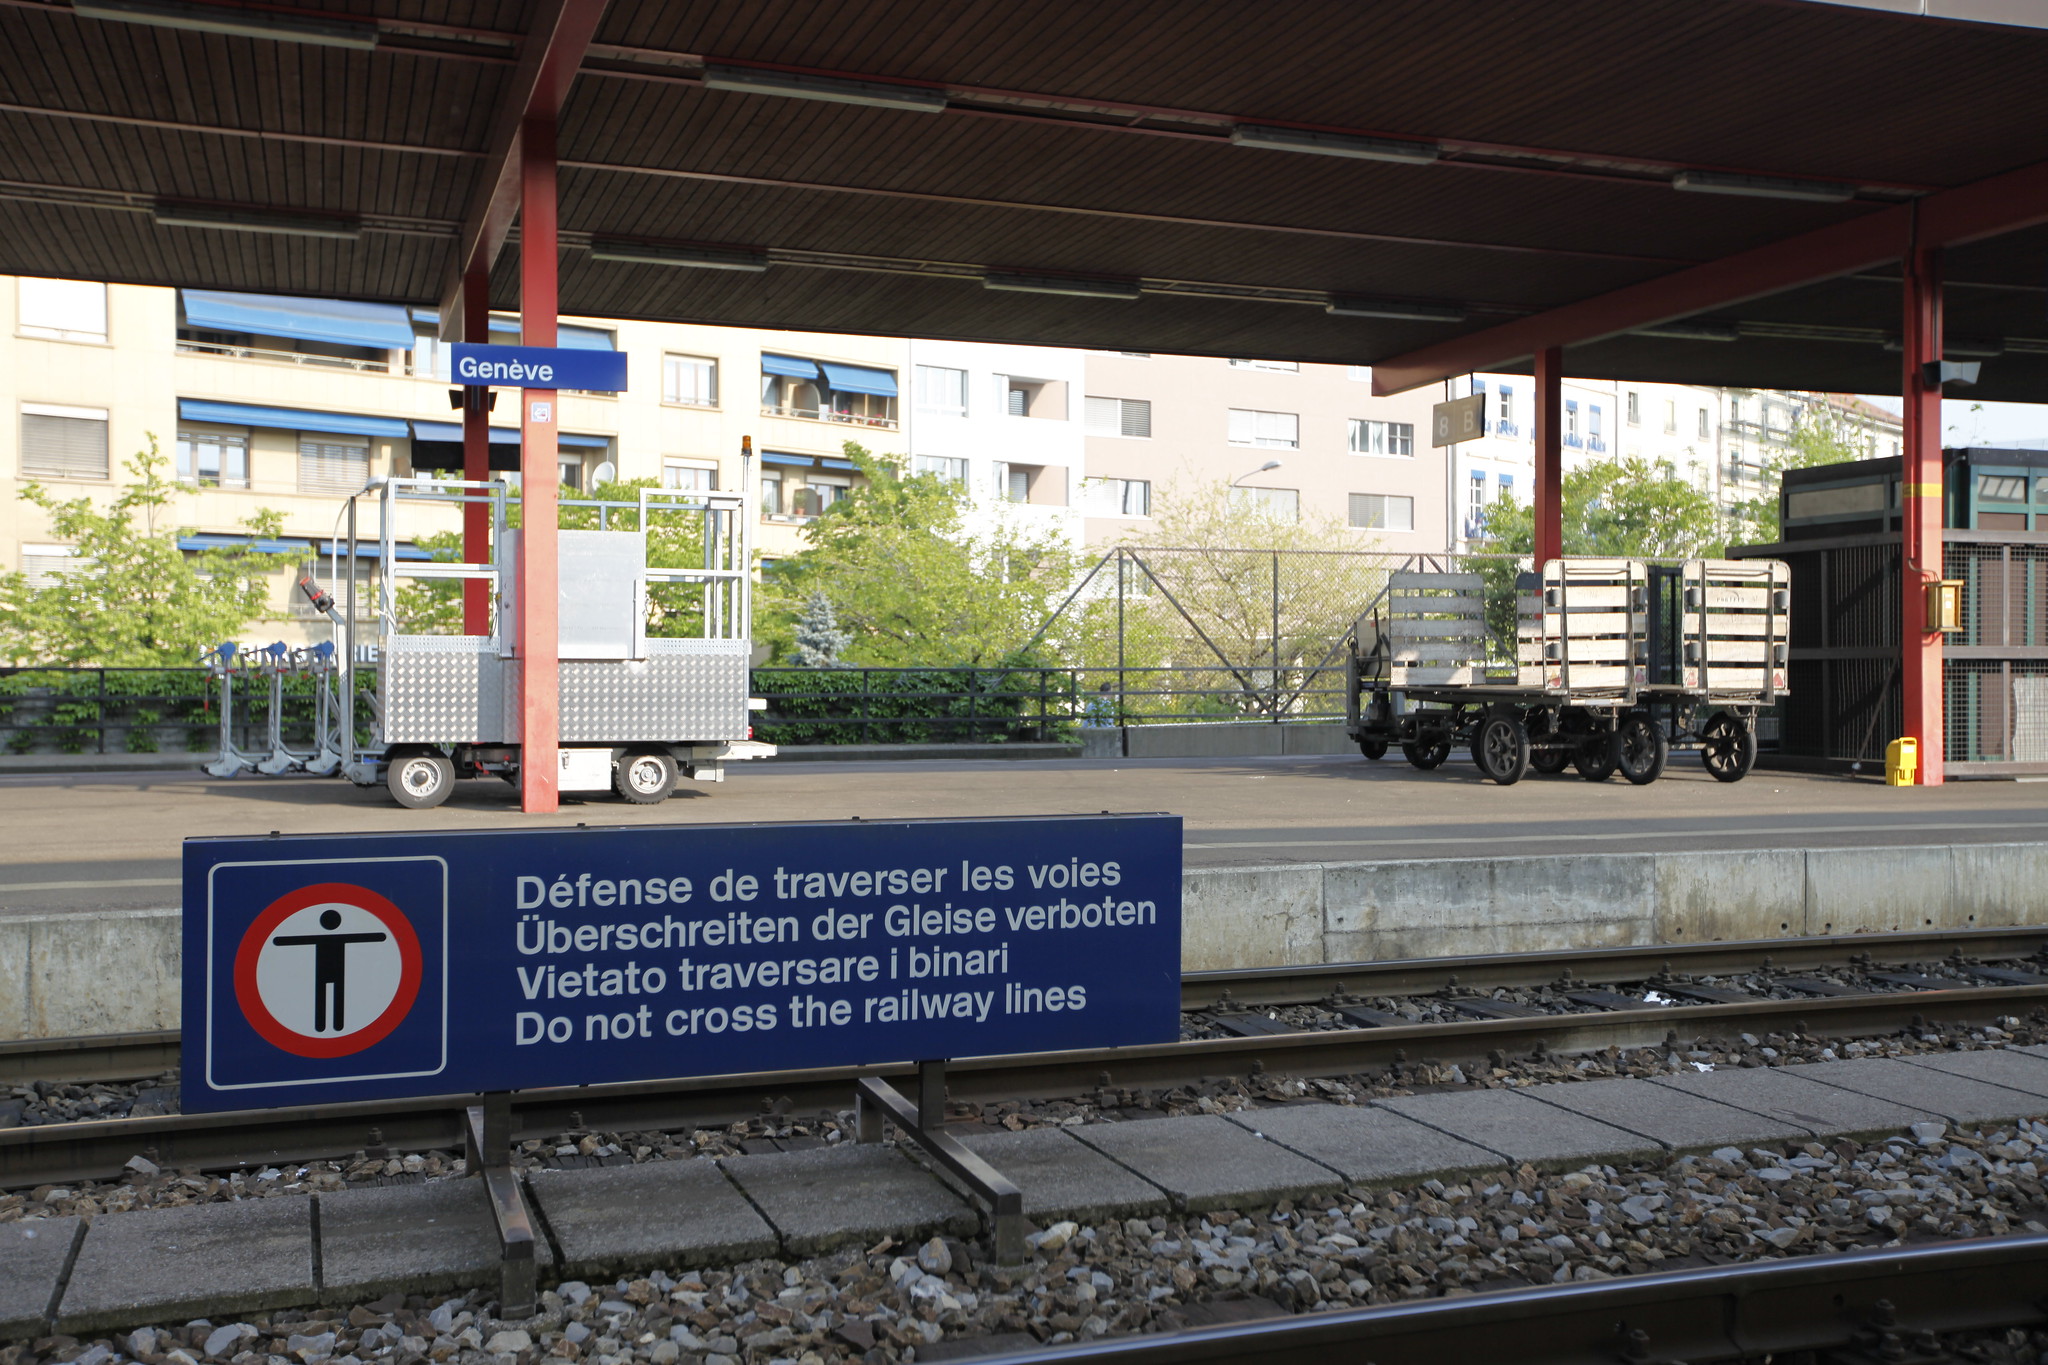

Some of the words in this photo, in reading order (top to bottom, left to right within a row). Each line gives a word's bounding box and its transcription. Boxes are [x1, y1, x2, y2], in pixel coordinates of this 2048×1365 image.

[459, 357, 553, 382] Genève
[1440, 416, 1449, 437] 8
[1464, 410, 1474, 432] B
[516, 873, 693, 909] Défense
[709, 869, 759, 902] de
[773, 866, 948, 900] traverser
[962, 860, 1015, 891] les
[1027, 857, 1121, 889] voies
[516, 911, 799, 955] Überschreiten
[811, 908, 874, 941] der
[884, 903, 996, 937] Gleise
[1004, 896, 1156, 932] verboten
[516, 961, 667, 1000] Vietato
[678, 954, 879, 992] traversare
[890, 947, 898, 979] i
[909, 942, 1008, 978] binari
[516, 1011, 573, 1045] Do
[585, 1004, 652, 1041] not
[665, 1003, 777, 1036] cross
[789, 994, 852, 1028] the
[864, 988, 994, 1023] railway
[1005, 982, 1087, 1014] lines
